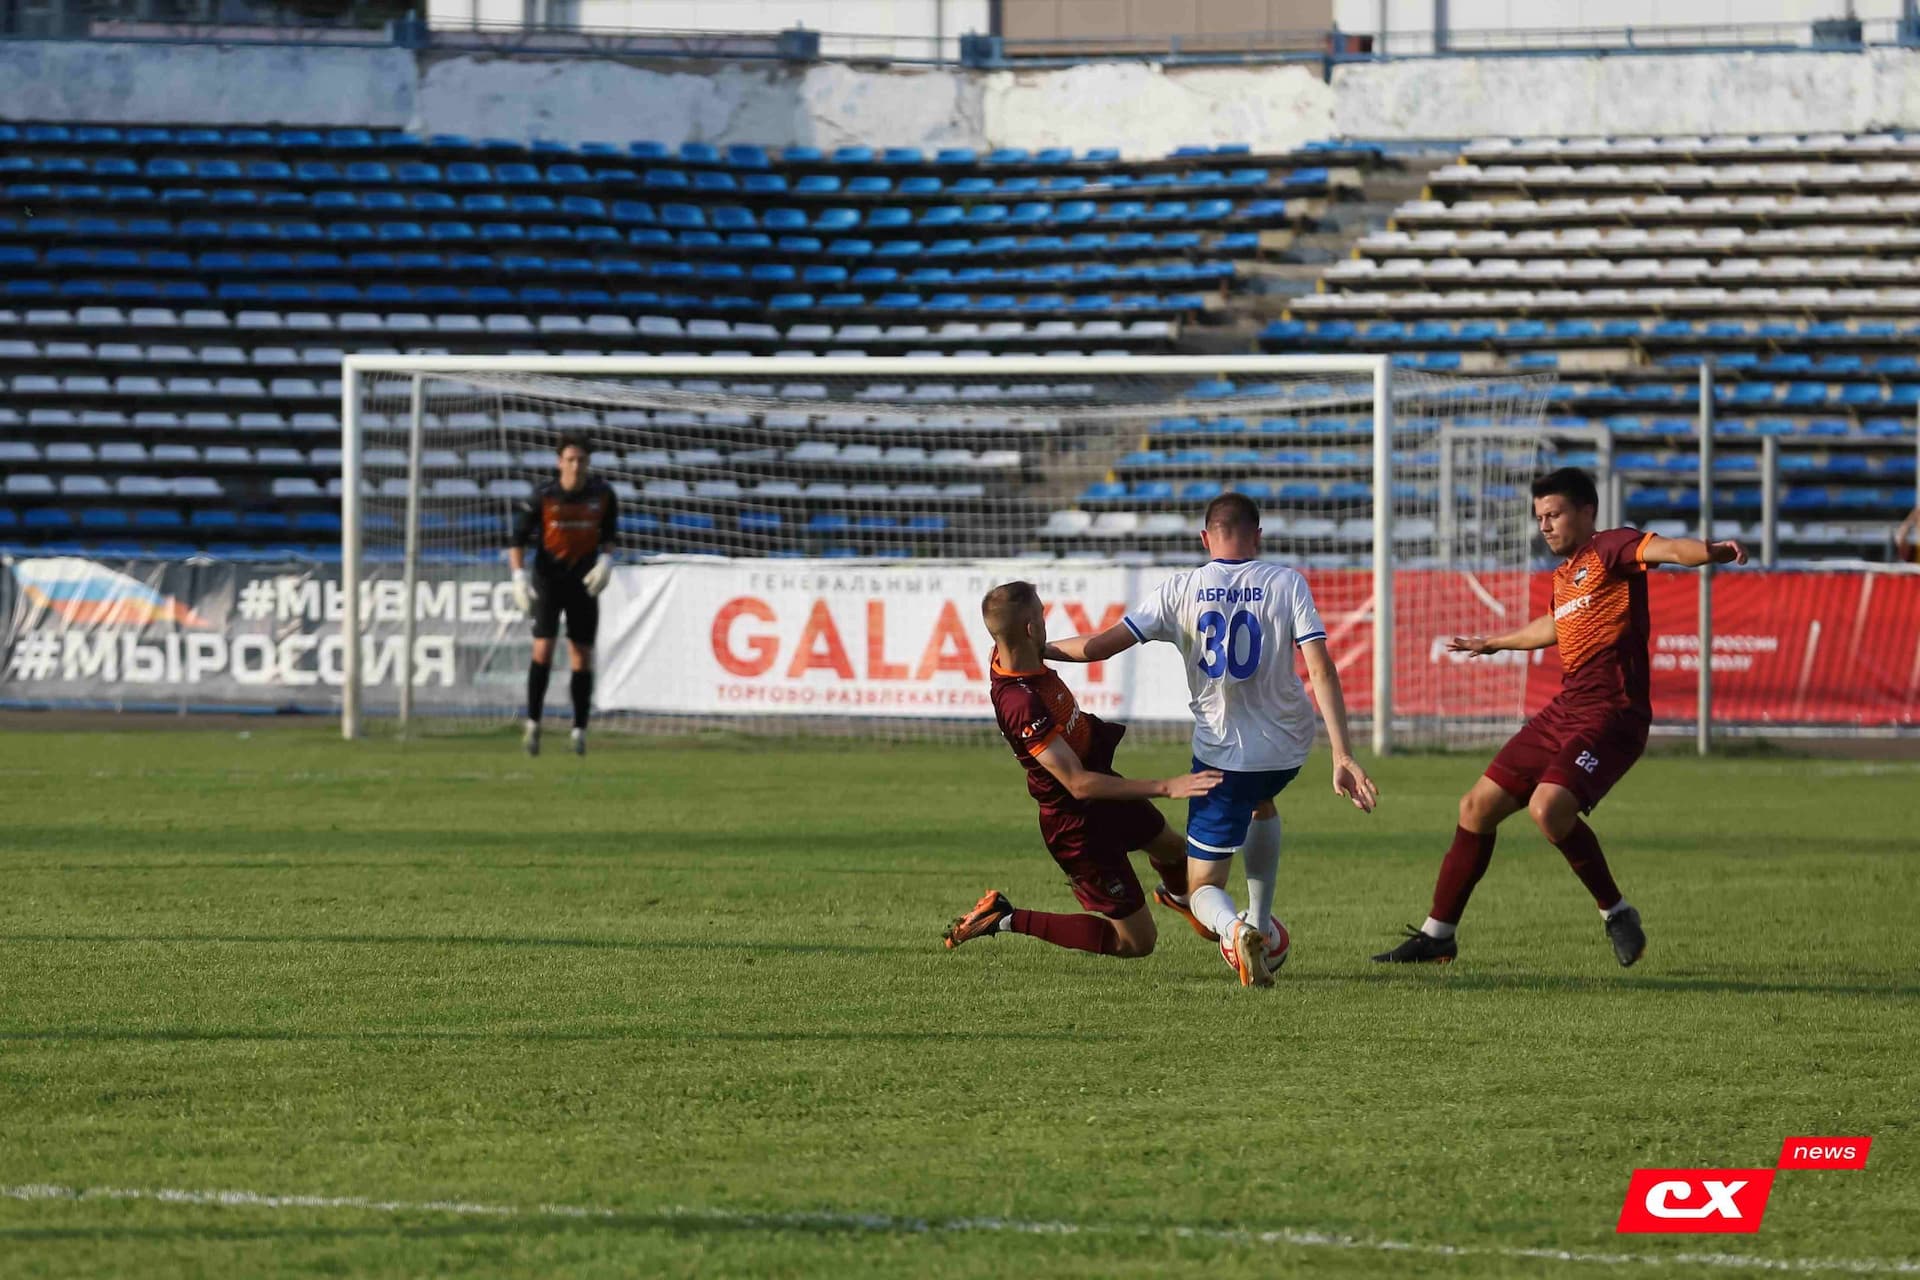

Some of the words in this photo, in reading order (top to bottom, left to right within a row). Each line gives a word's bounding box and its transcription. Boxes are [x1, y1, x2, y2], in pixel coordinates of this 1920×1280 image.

[967, 575, 1088, 594] ПАНЕР
[1197, 587, 1263, 604] АБРАМОВ
[237, 578, 526, 622] #МЫВМЕС
[710, 595, 1127, 684] GALAY
[1197, 610, 1262, 680] 30
[717, 684, 988, 706] ТОРГОВО-РАЗВЛЕКАТЕЛЬ
[1574, 749, 1599, 774] 22
